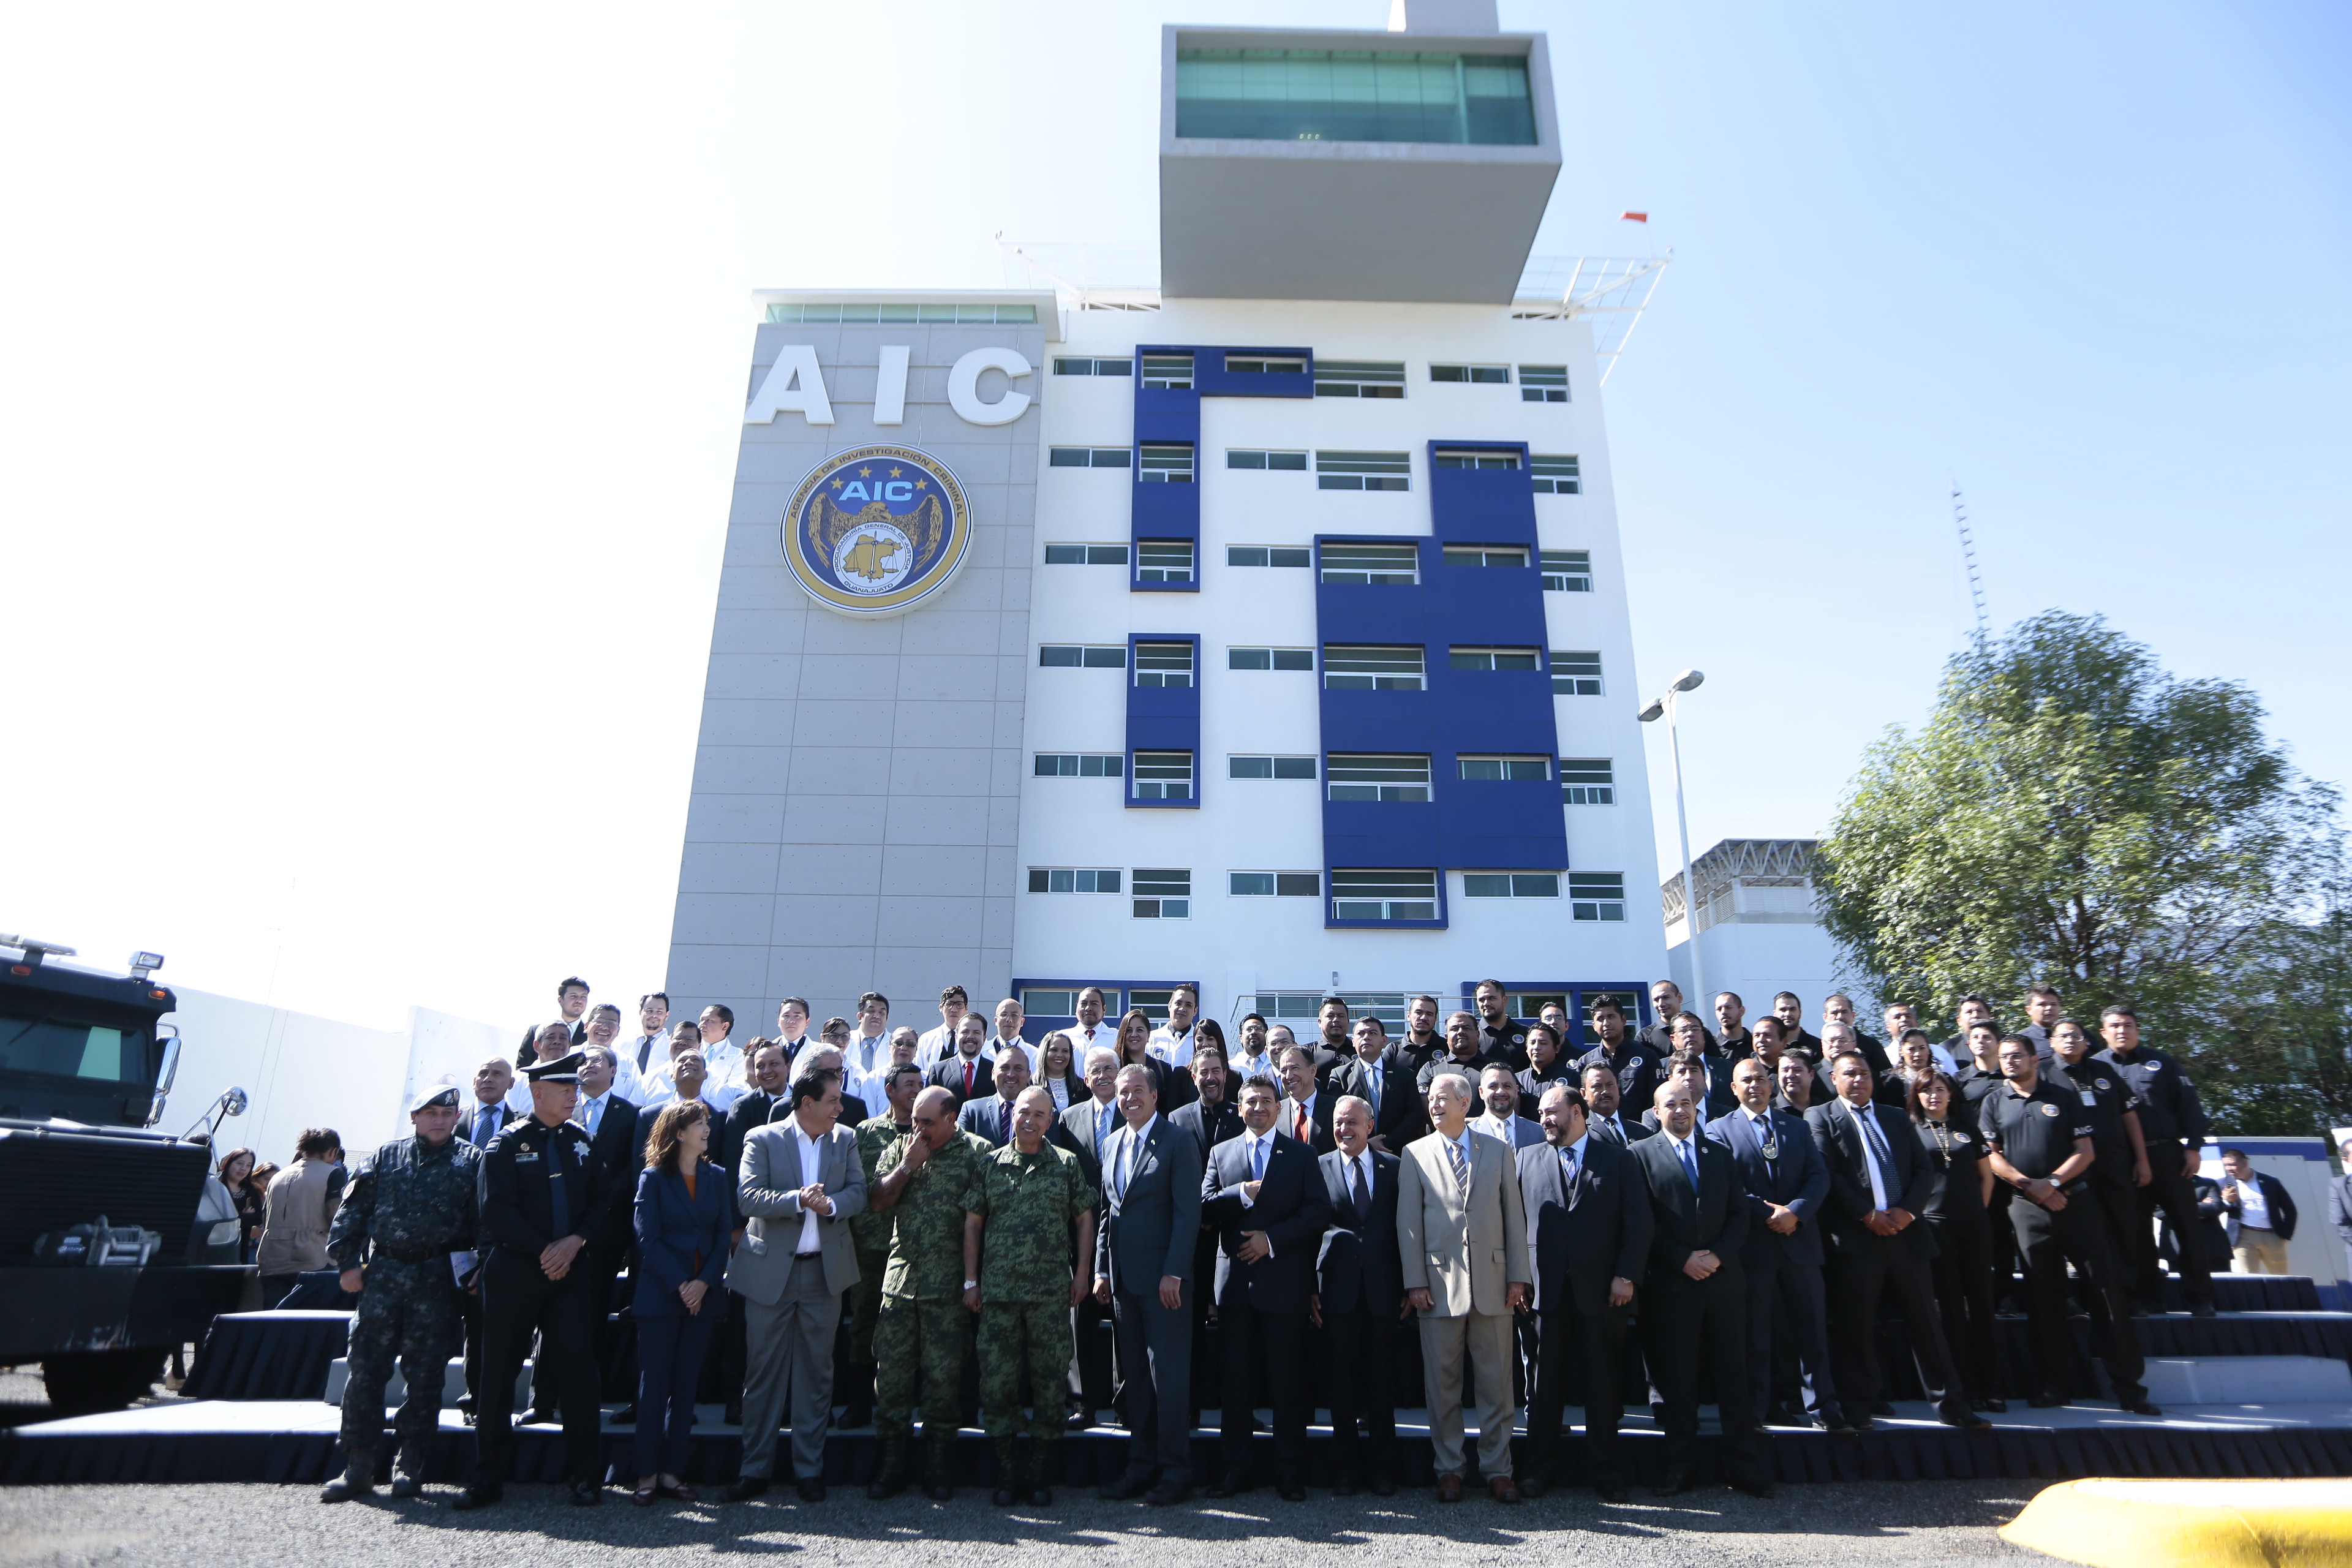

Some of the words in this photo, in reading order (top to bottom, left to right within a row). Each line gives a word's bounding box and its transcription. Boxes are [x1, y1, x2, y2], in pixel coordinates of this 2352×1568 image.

[744, 344, 1032, 426] AIC
[790, 474, 821, 519] AGENCIA
[821, 461, 837, 474] DE
[838, 448, 930, 467] INVESTIGACIÓN
[933, 466, 964, 518] CRIMINAL
[838, 480, 913, 502] AIC
[834, 526, 862, 573] PROCURADURÍA
[864, 522, 896, 533] GENERAL
[897, 532, 907, 541] DE
[903, 541, 912, 570] JUSTICIA
[843, 580, 894, 594] GUANAJUATO
